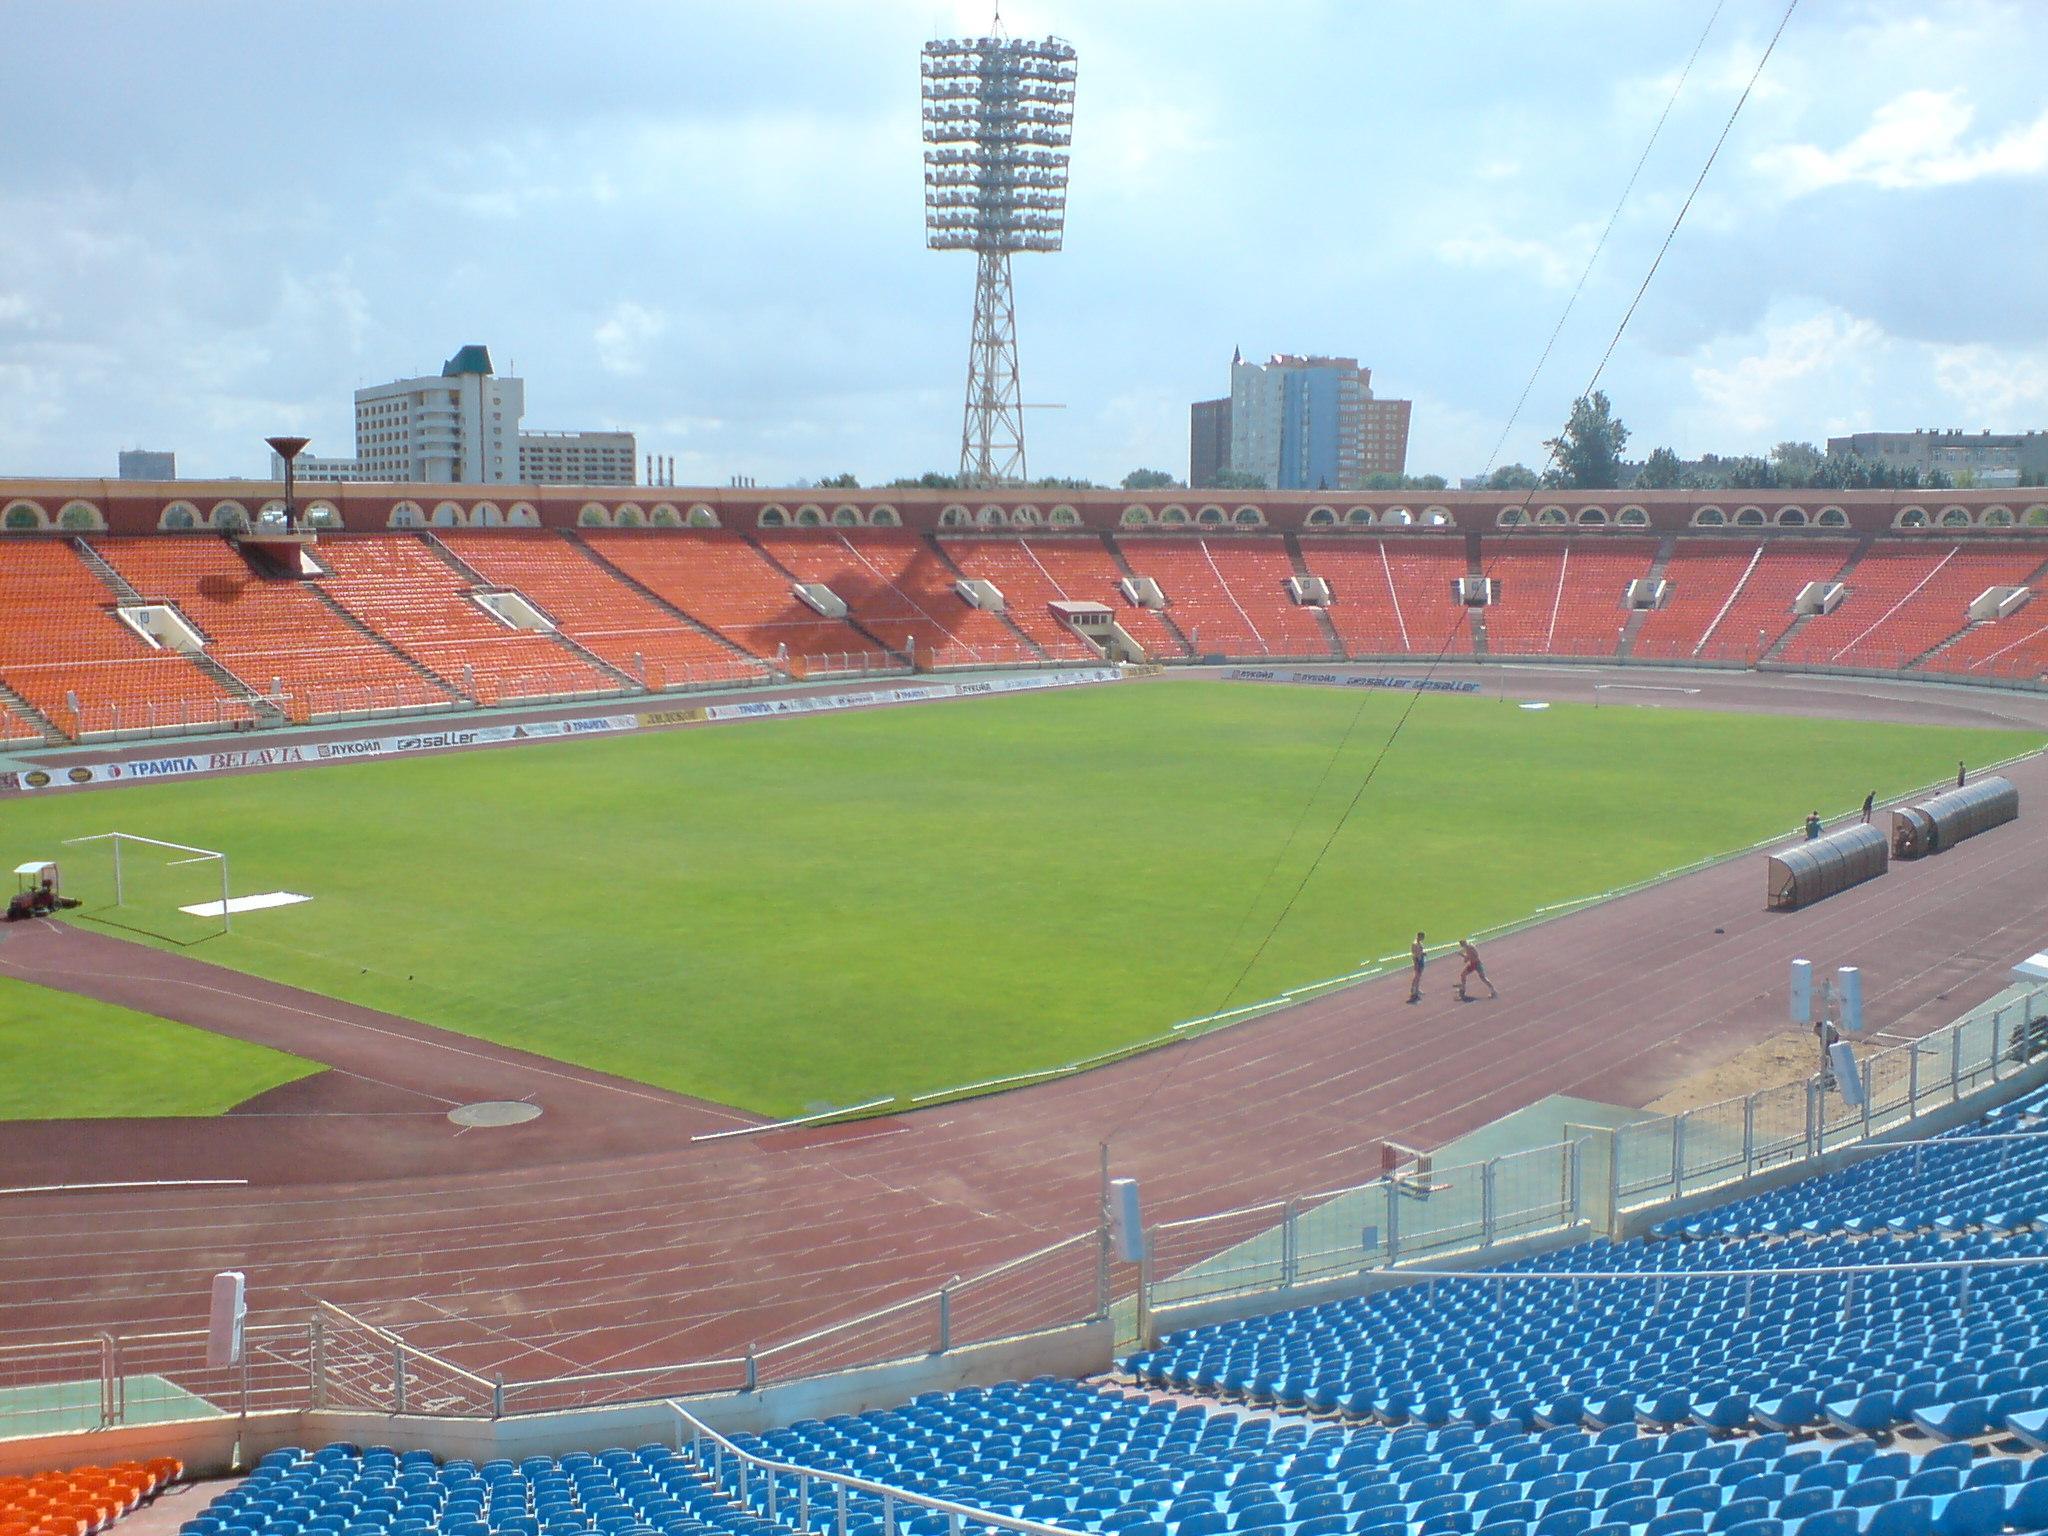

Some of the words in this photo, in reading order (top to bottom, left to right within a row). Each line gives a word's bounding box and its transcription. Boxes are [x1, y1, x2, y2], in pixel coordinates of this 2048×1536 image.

[330, 739, 381, 756] ЛУКОЙЛ
[423, 731, 479, 749] saller
[209, 746, 303, 769] BELAVIA
[129, 758, 198, 776] ТРАЙПЛ
